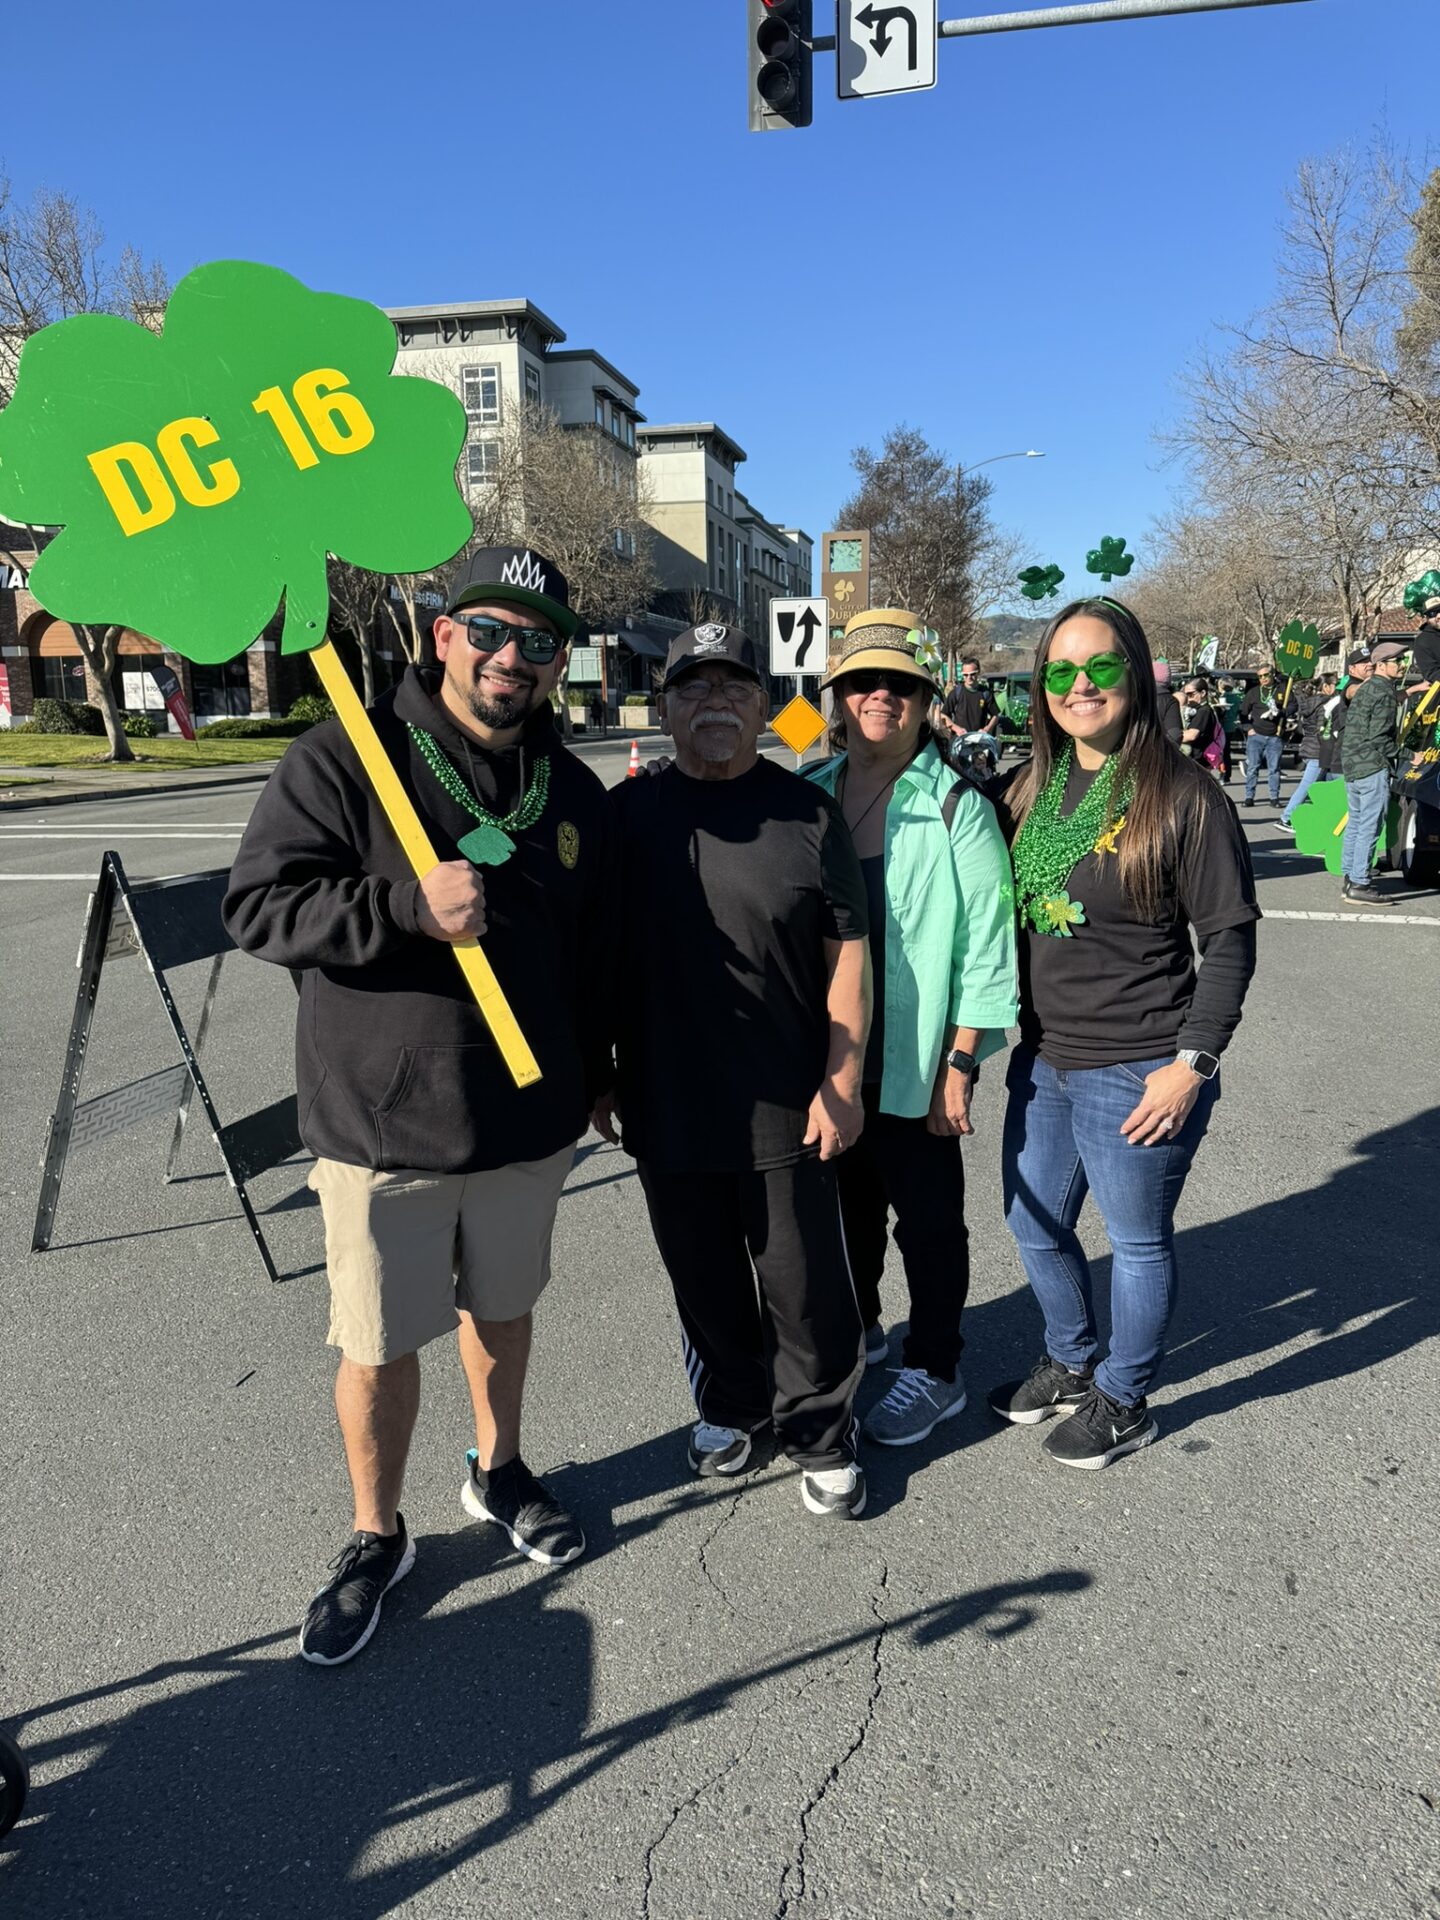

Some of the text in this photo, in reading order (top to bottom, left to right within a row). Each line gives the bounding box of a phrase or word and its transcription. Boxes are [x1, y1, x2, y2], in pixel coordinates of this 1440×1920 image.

[87, 367, 376, 537] DC 16
[1286, 639, 1314, 660] DC 16
